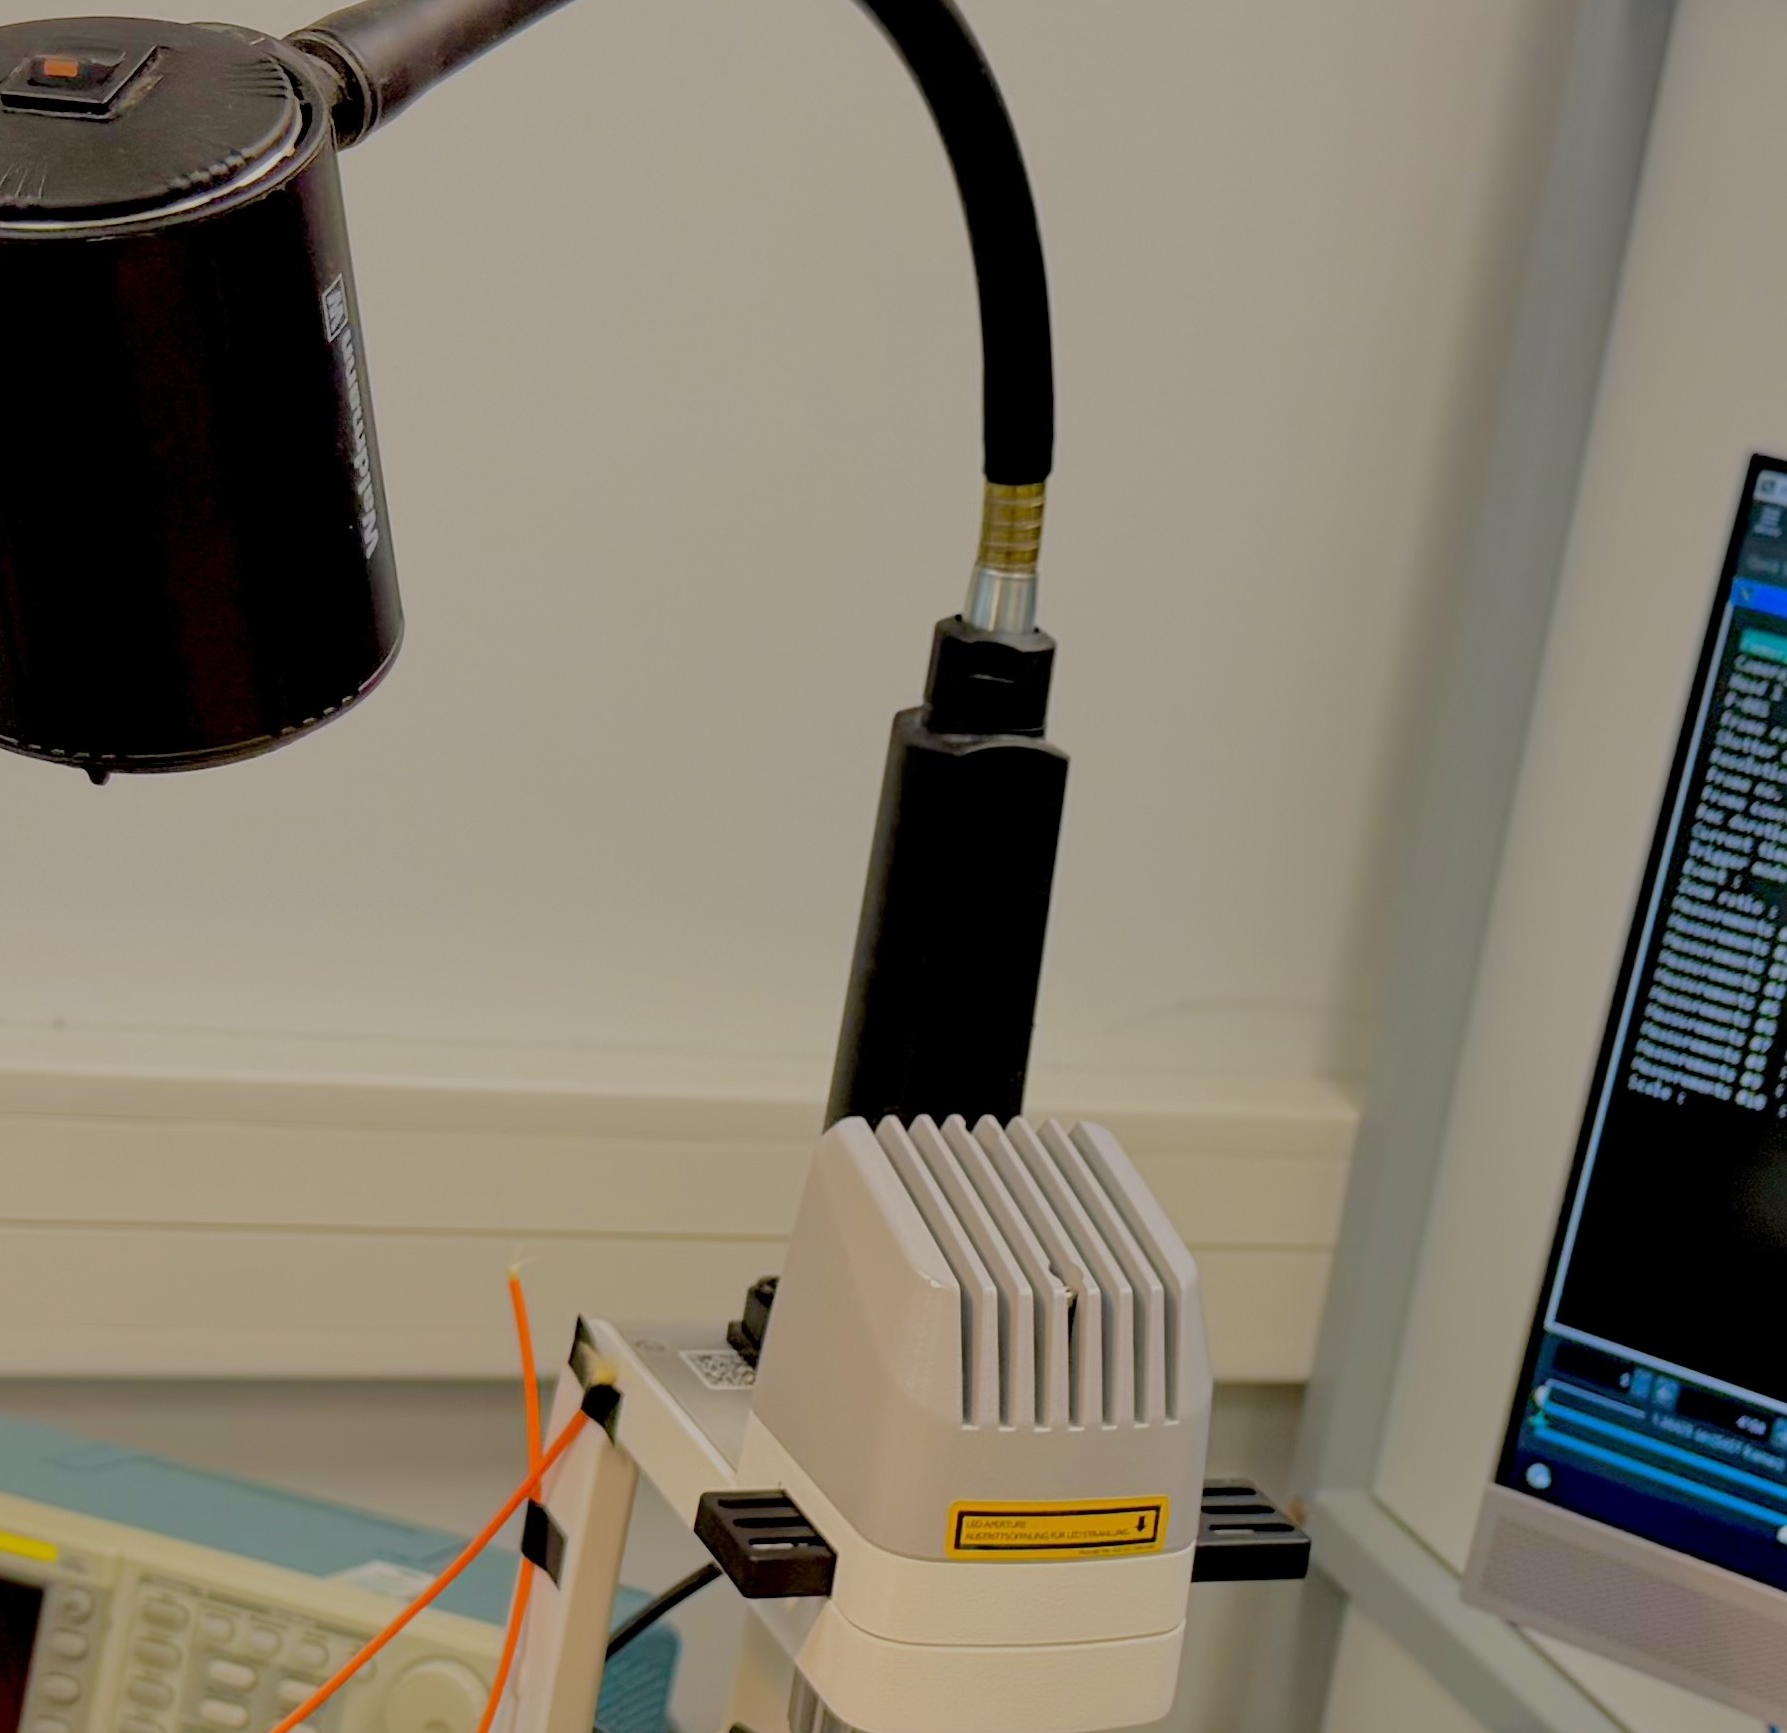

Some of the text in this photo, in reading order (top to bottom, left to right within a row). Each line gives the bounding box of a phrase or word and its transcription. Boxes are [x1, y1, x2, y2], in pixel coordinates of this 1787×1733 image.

[1719, 711, 1767, 737] Frame
[1714, 729, 1779, 760] Shutter
[1704, 766, 1753, 793] Frame
[1699, 785, 1748, 812] Frame
[1689, 821, 1755, 854] Current
[1686, 840, 1750, 873] Trigger
[1716, 888, 1766, 917] ratio
